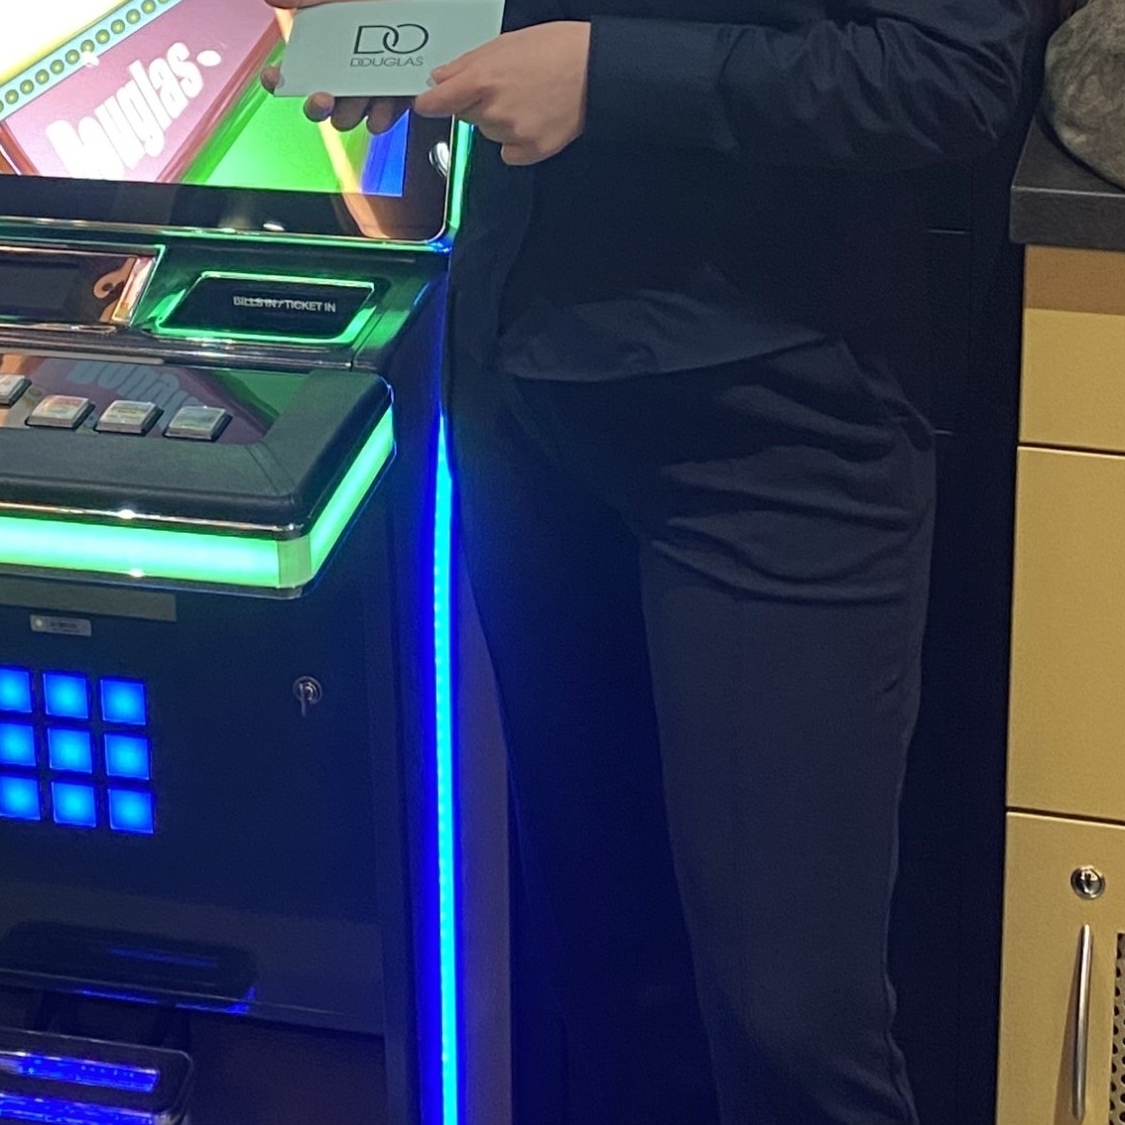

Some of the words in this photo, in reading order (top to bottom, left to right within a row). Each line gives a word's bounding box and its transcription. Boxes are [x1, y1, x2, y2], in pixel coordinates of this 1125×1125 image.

[349, 56, 424, 68] DOUGLAS
[284, 299, 323, 311] TICKET
[324, 302, 336, 313] IN
